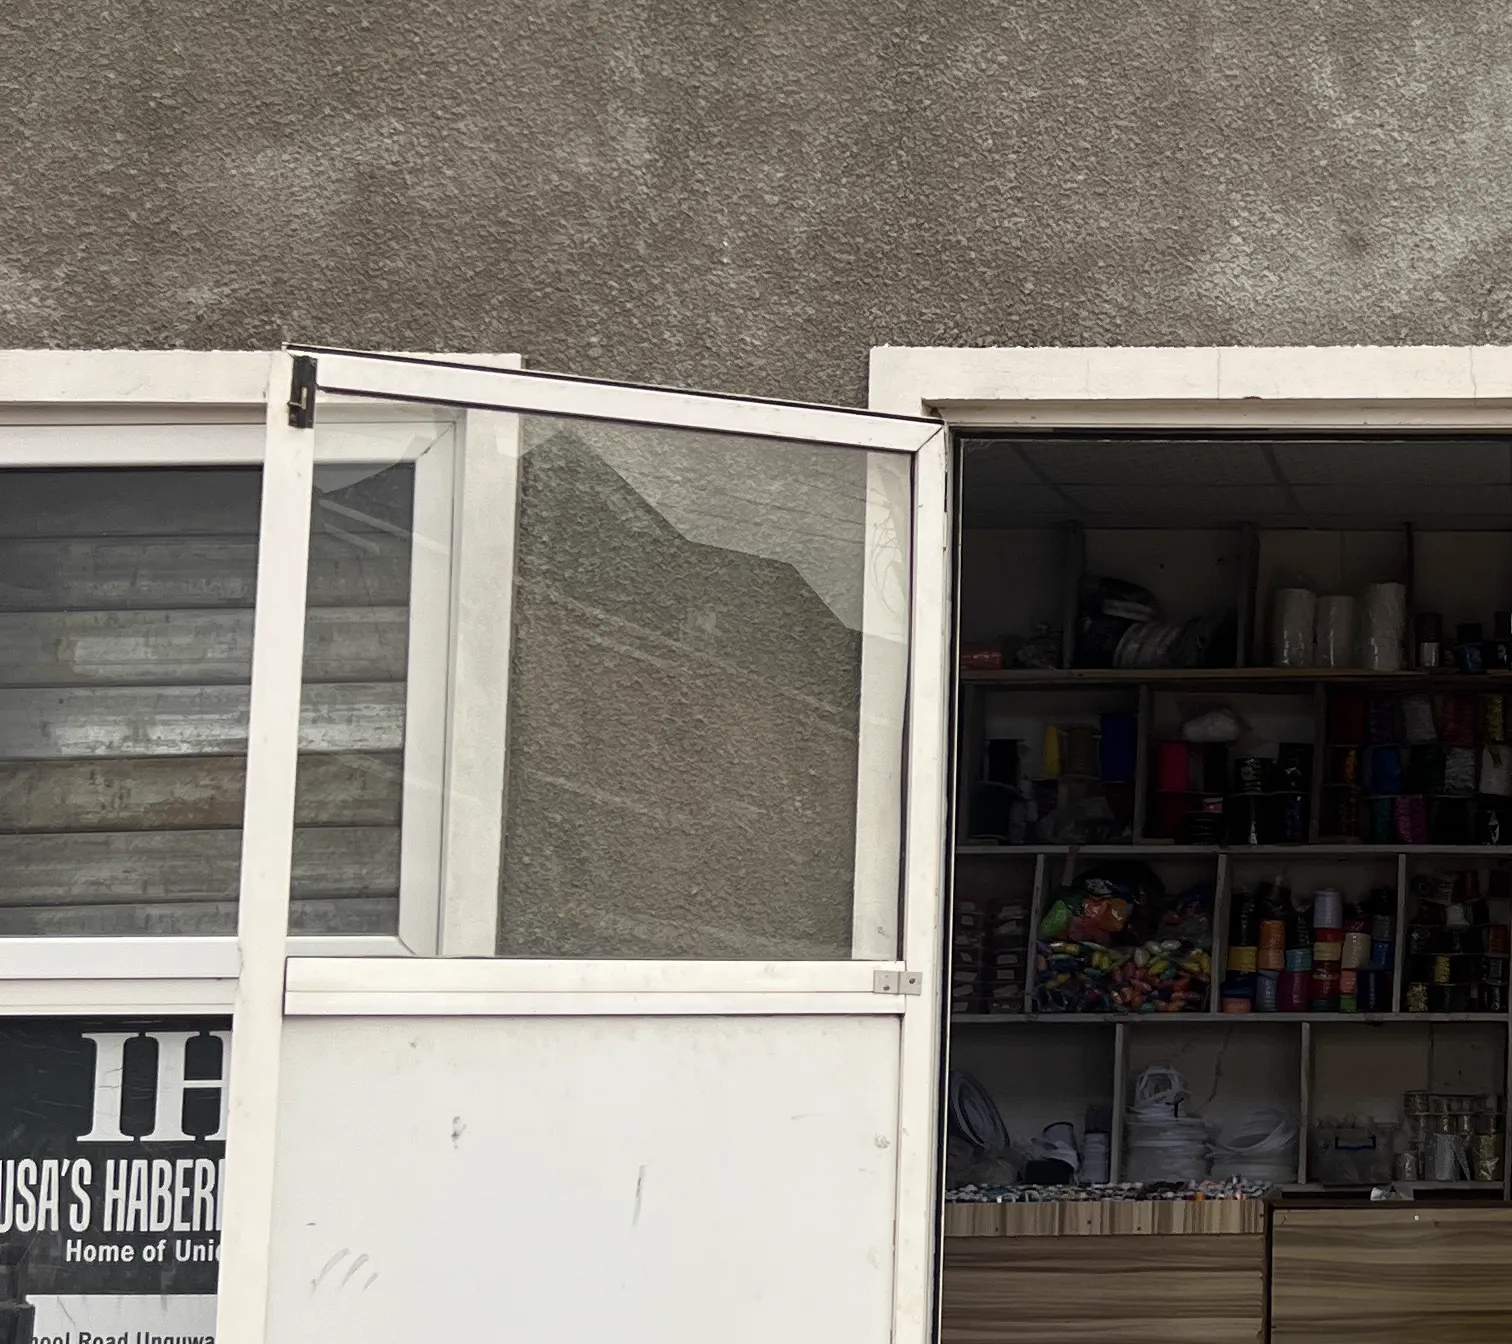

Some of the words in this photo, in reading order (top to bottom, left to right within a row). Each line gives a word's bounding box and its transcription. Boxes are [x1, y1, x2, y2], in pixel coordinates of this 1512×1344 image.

[103, 1158, 226, 1232] HABER
[66, 1239, 135, 1262] Home
[142, 1239, 167, 1262] of
